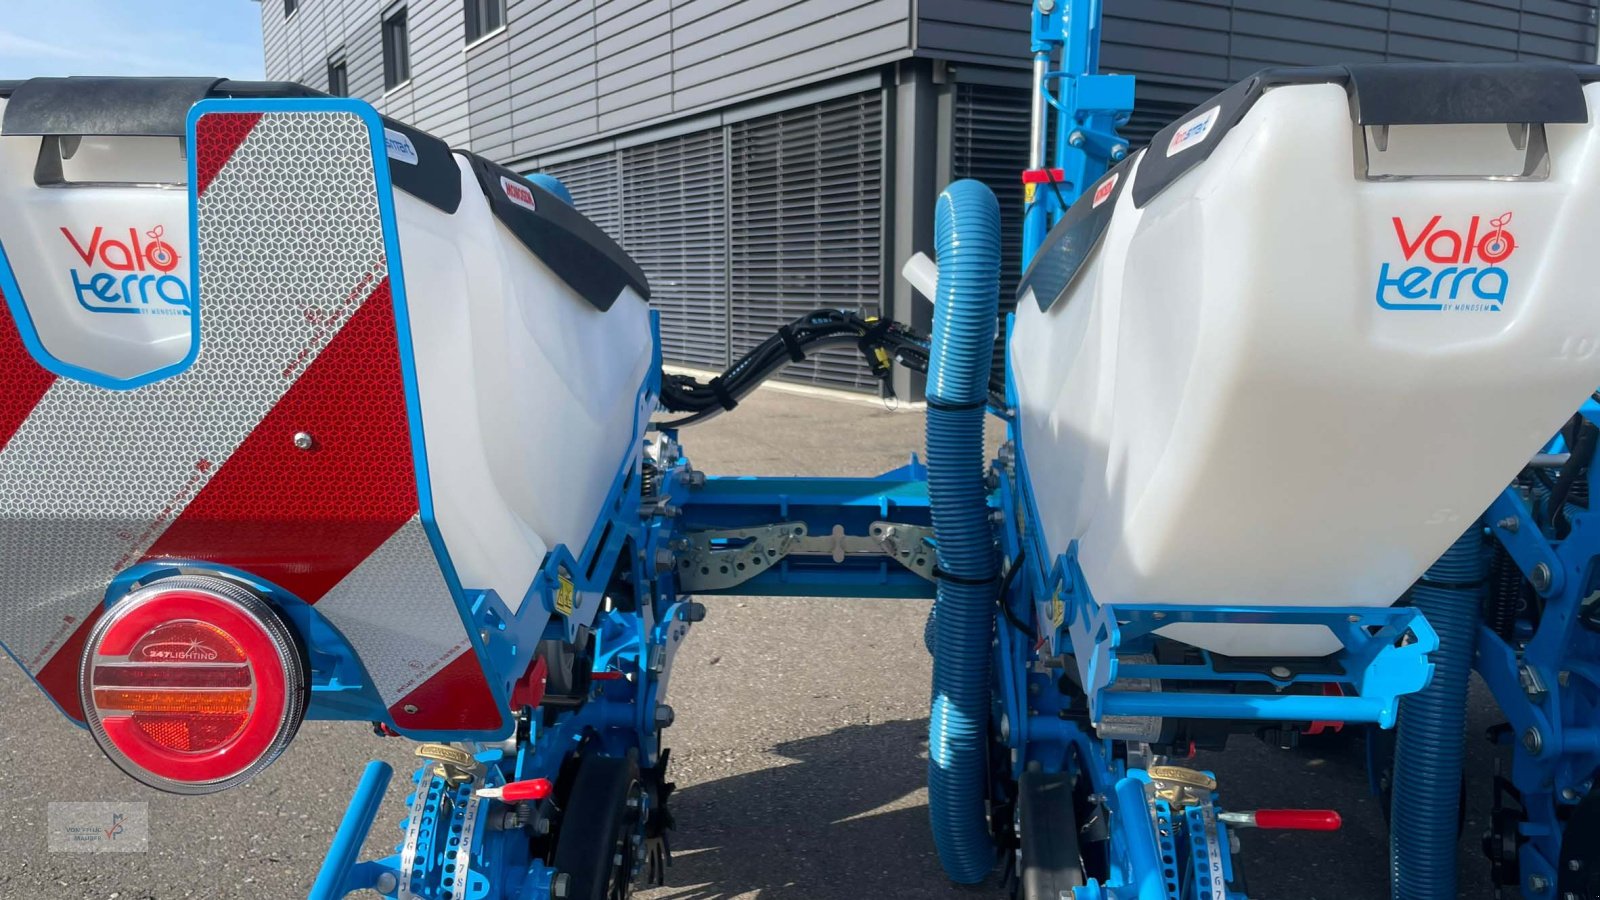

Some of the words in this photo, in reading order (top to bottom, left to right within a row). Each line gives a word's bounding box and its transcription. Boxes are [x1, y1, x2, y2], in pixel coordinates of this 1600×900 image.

[59, 226, 179, 272] Valo
[1391, 215, 1516, 264] Valo
[70, 268, 191, 314] terra
[1376, 262, 1509, 310] terra
[1455, 303, 1490, 312] MONOSEM
[149, 650, 216, 660] 247LIGHTING
